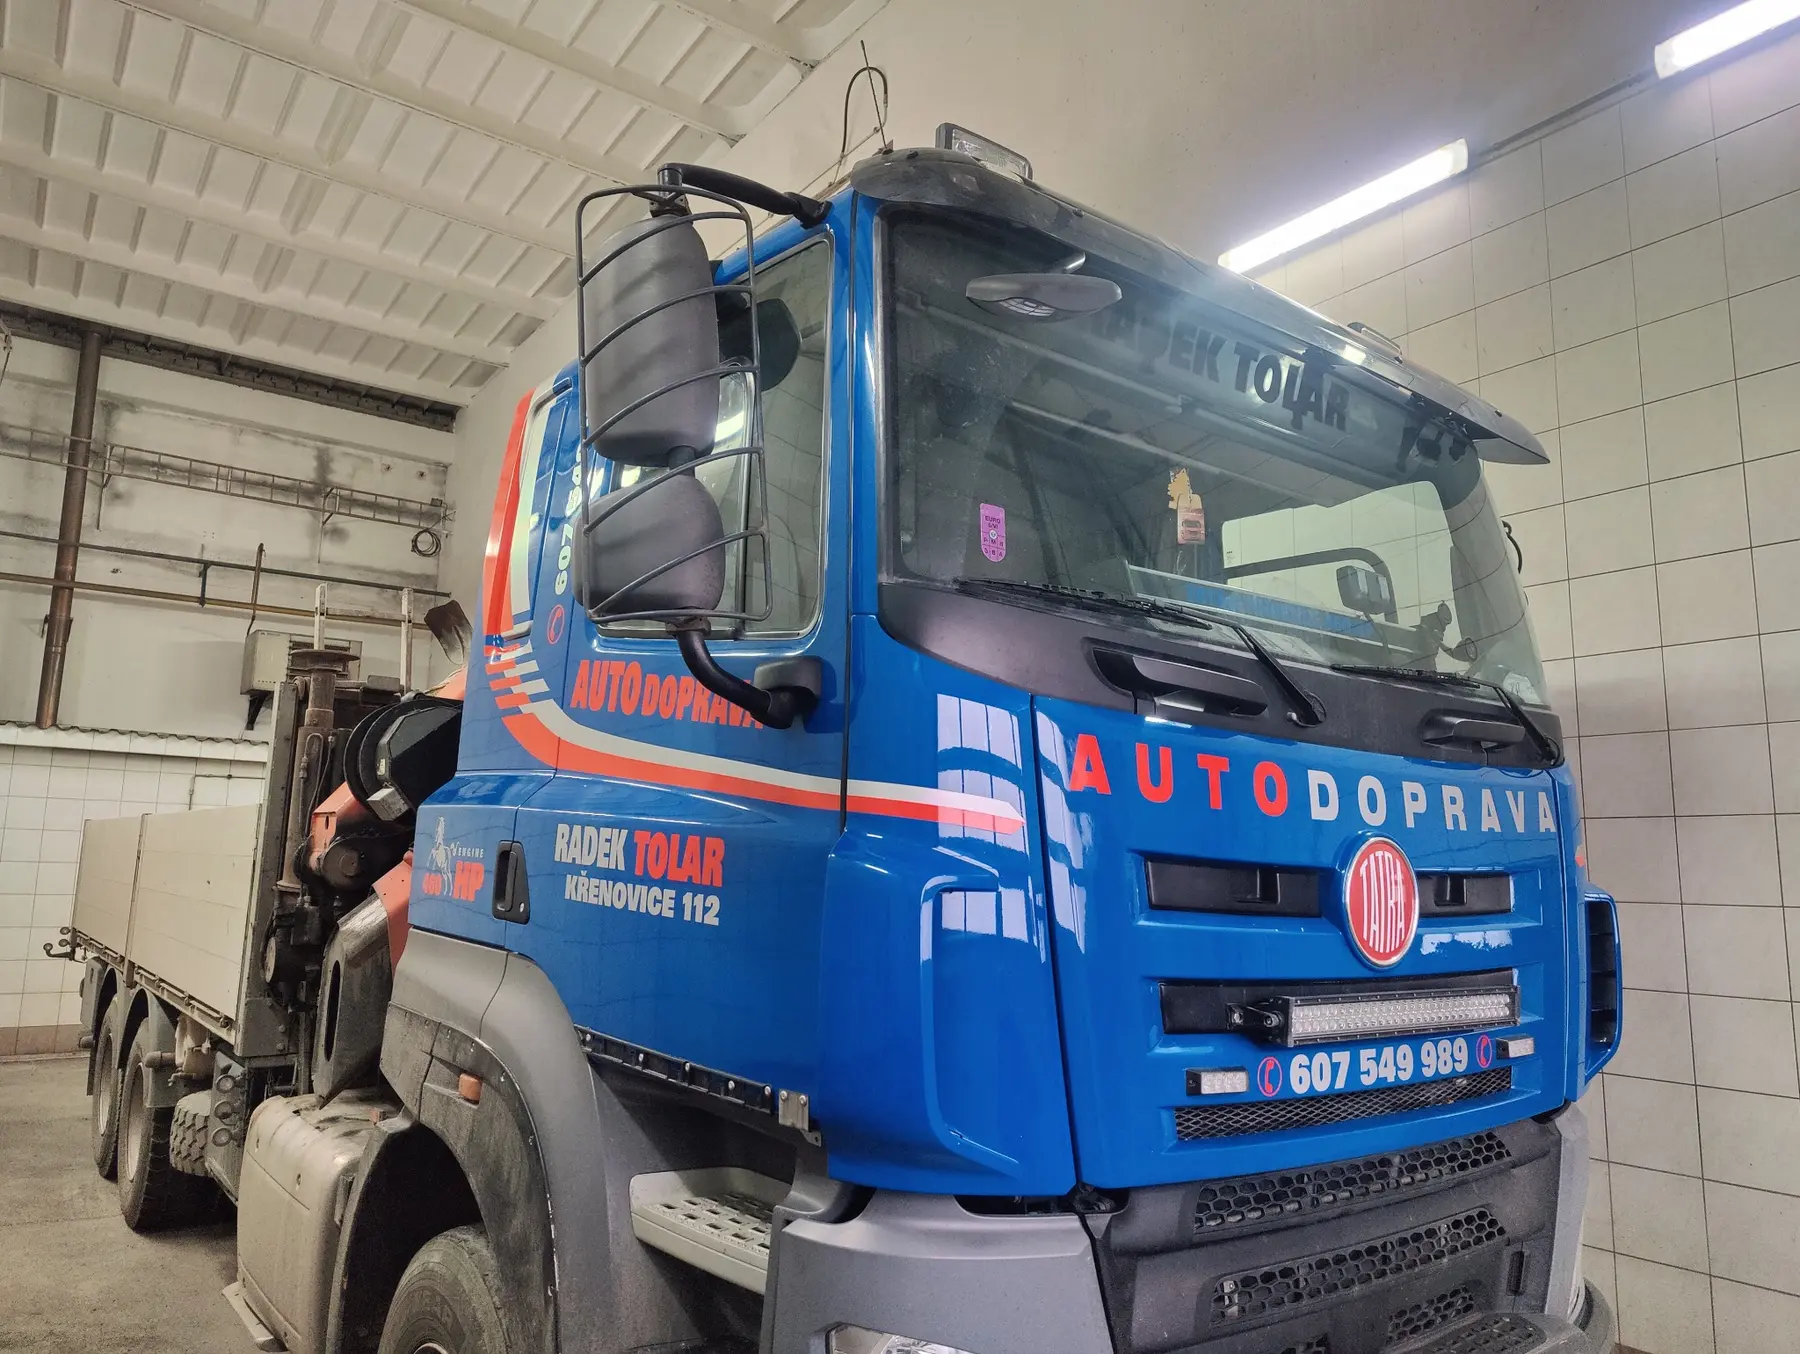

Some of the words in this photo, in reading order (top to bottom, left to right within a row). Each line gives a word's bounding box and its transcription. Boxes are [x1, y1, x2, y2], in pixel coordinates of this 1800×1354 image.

[1069, 733, 1557, 833] AUTODOPRAVA
[452, 860, 485, 903] HP
[554, 823, 628, 871] RADEK
[634, 830, 726, 887] TOLAR
[564, 870, 676, 918] KŘENOVICE
[682, 892, 721, 926] 112
[1360, 850, 1405, 953] TATRA
[1289, 1051, 1350, 1095] 607
[1359, 1044, 1414, 1086] 549
[1420, 1037, 1468, 1077] 989
